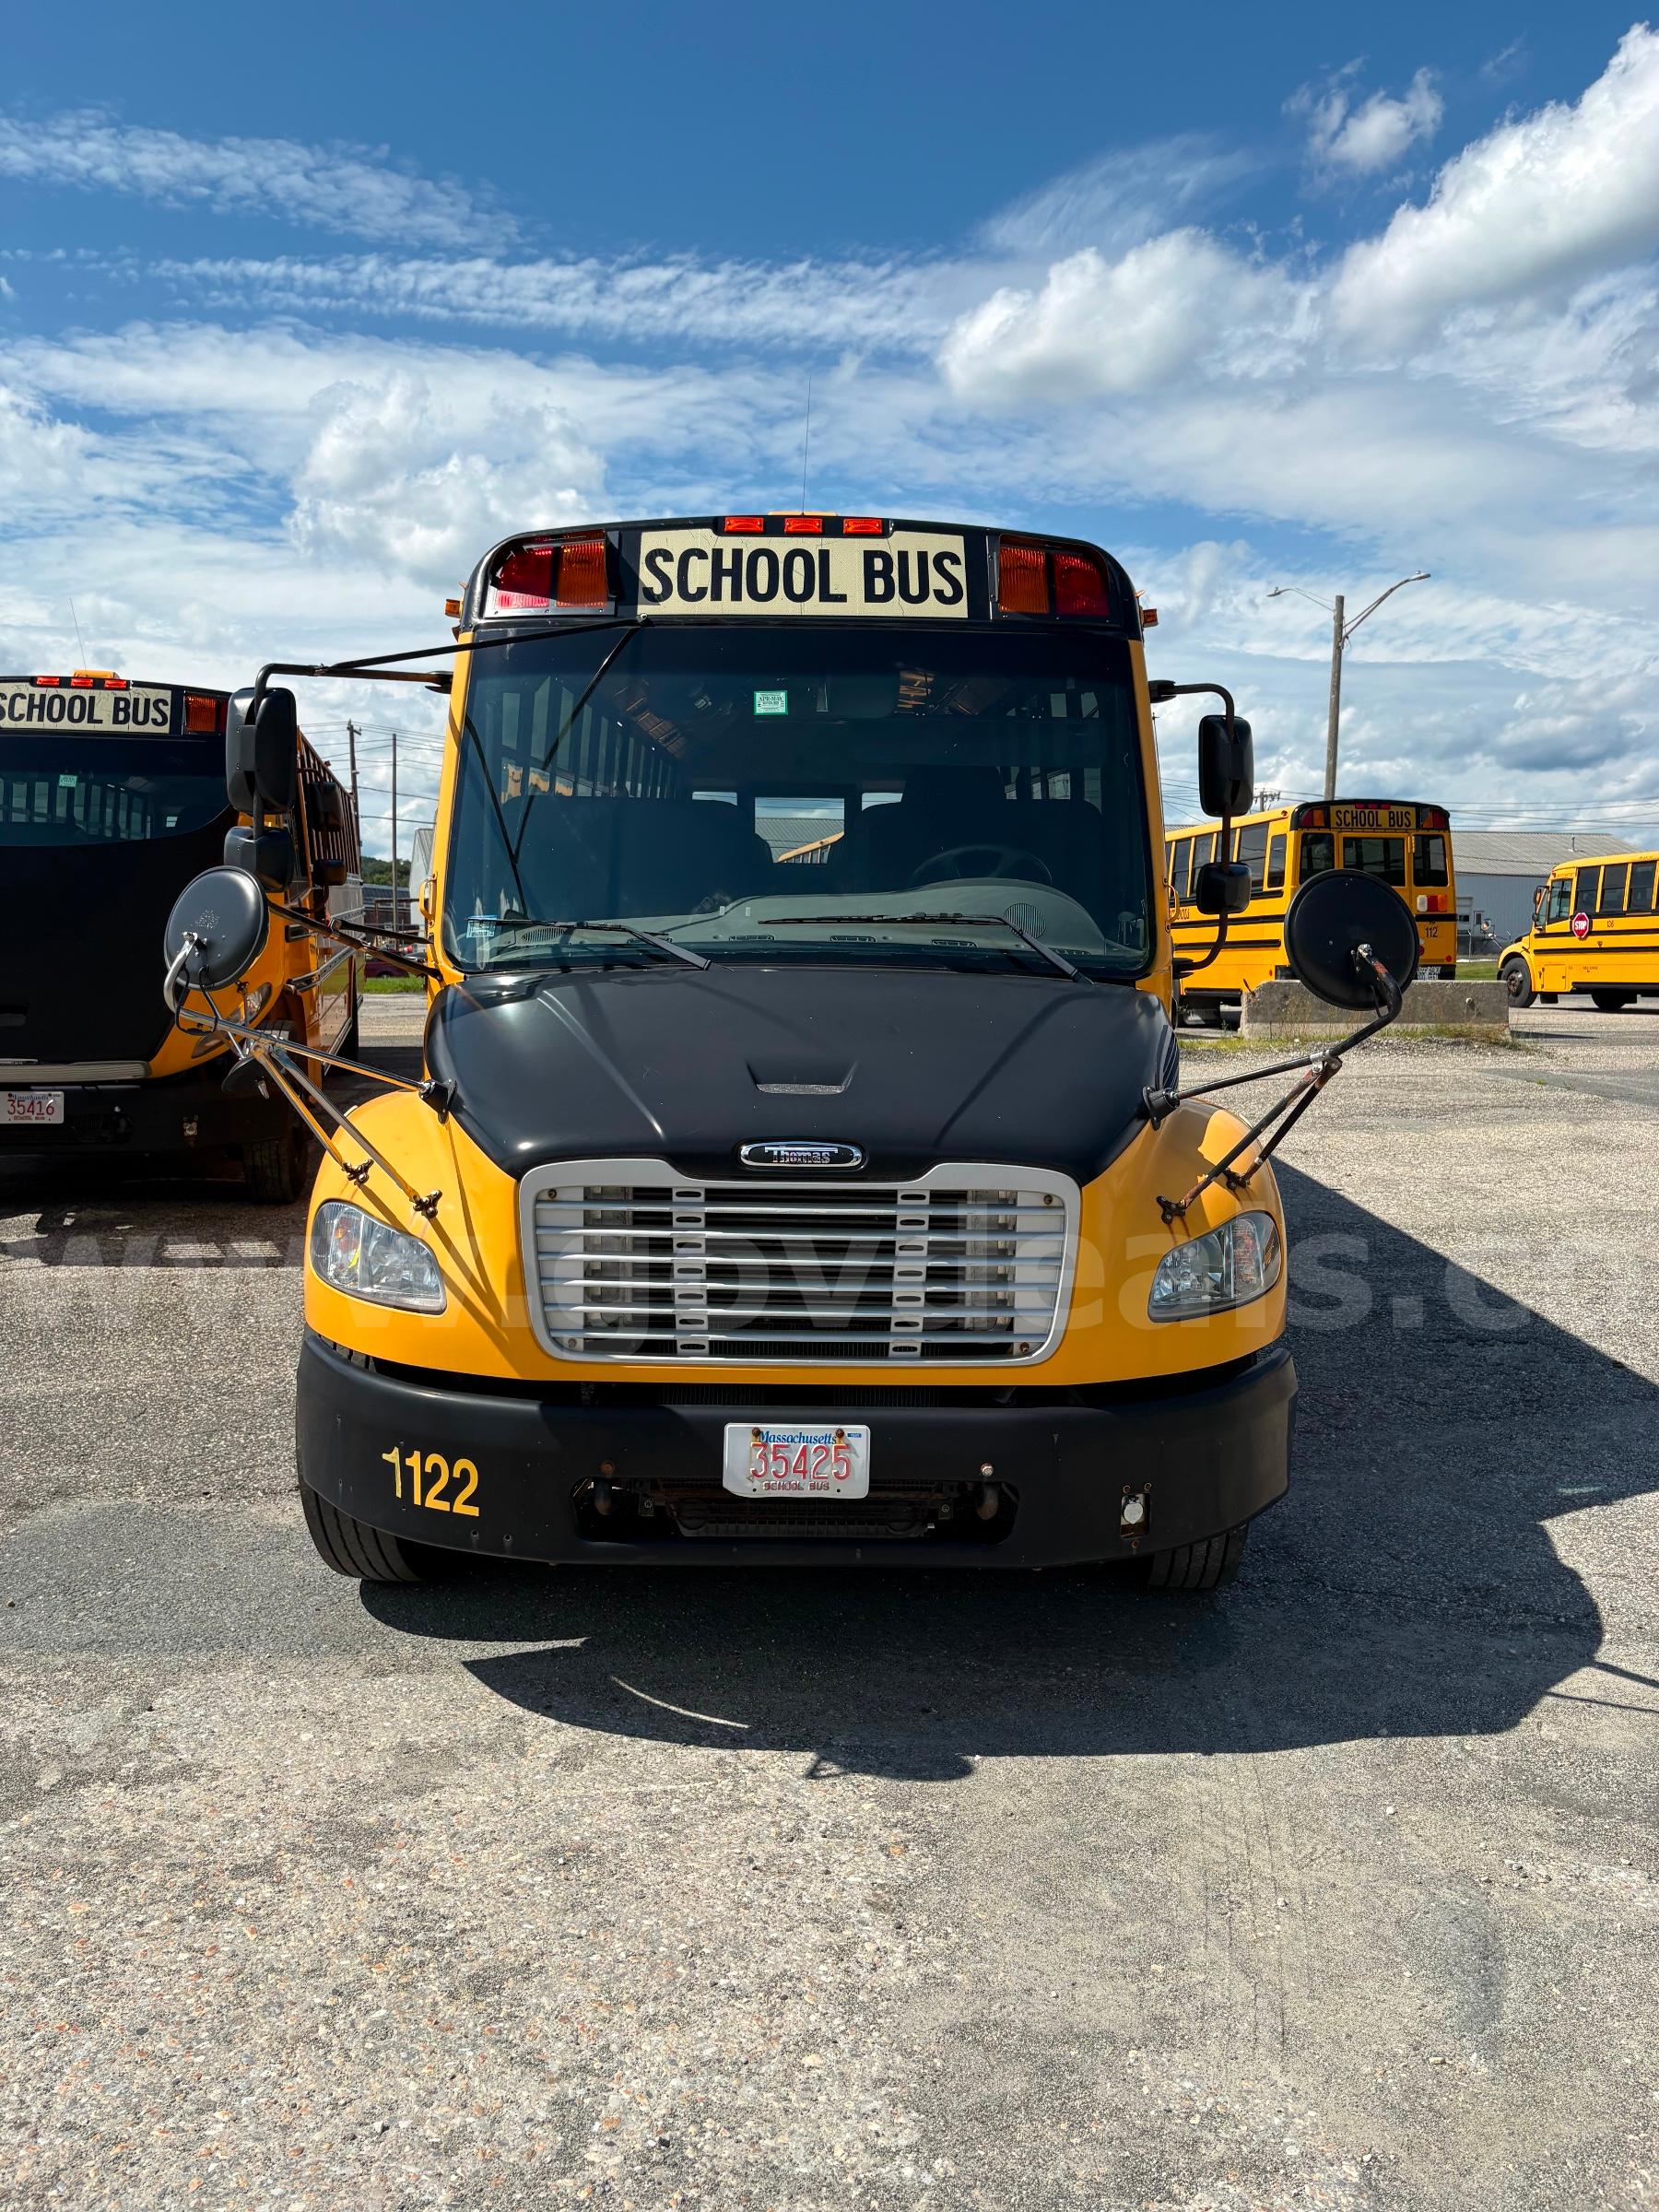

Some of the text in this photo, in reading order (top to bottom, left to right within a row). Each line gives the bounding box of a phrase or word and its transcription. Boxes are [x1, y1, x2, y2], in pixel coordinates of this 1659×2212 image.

[642, 547, 964, 606] SCHOOL BUS
[112, 697, 169, 726] BUS
[1335, 809, 1412, 827] SCHOOL BUS
[1425, 926, 1438, 938] 112
[1574, 921, 1587, 931] STOP
[7, 1099, 54, 1115] 35416
[764, 1147, 838, 1163] Thomas
[759, 1430, 837, 1445] Massachusetts
[750, 1441, 852, 1480] 35425
[382, 1446, 479, 1517] 1122
[762, 1480, 830, 1491] SCHOOL BUS
